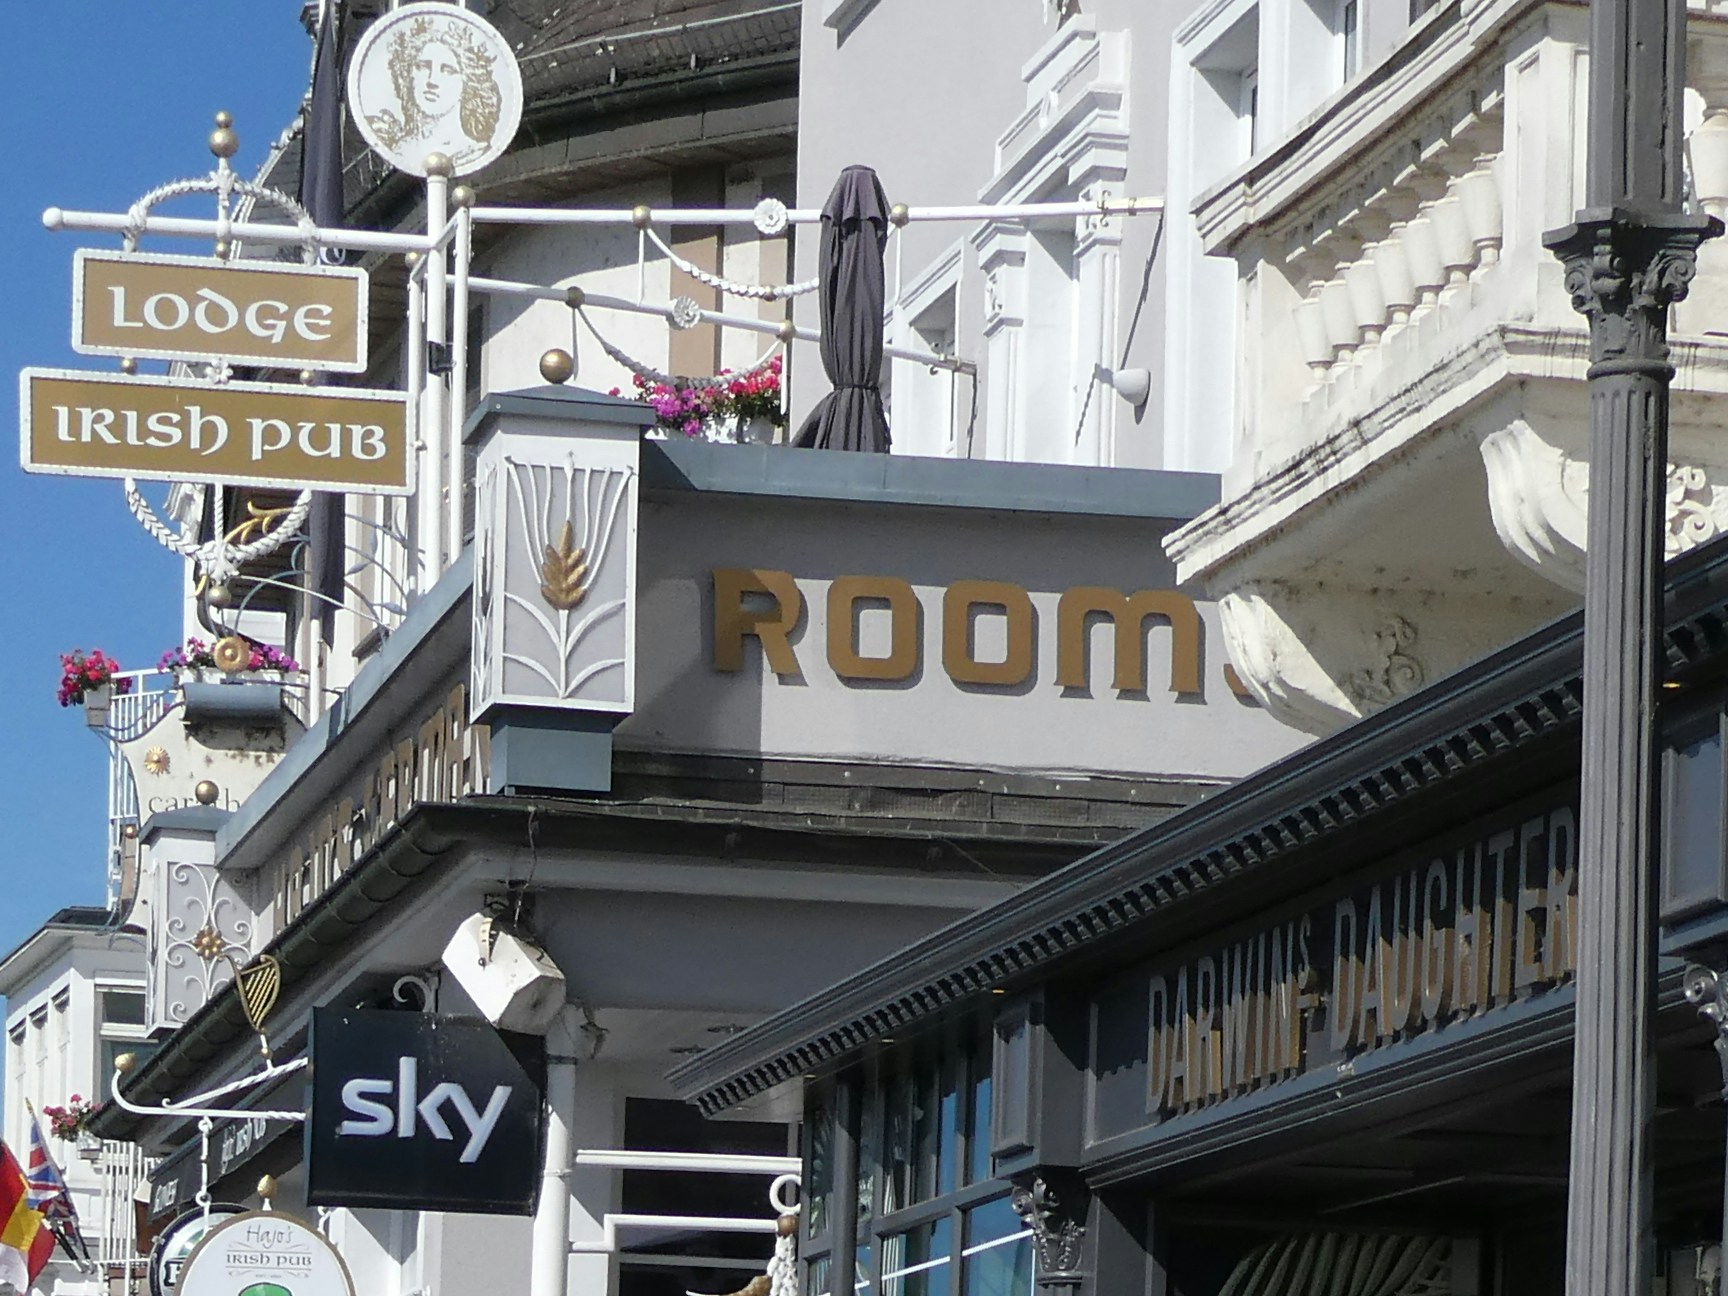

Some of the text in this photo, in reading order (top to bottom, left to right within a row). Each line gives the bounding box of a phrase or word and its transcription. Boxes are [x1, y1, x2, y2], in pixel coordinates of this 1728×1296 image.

[108, 286, 334, 344] LODGE
[52, 405, 387, 461] IRISH PUB
[712, 568, 1251, 697] ROOM
[341, 1056, 513, 1163] sky
[226, 1253, 312, 1267] IRISH PUB
[247, 1224, 293, 1249] Hajo's
